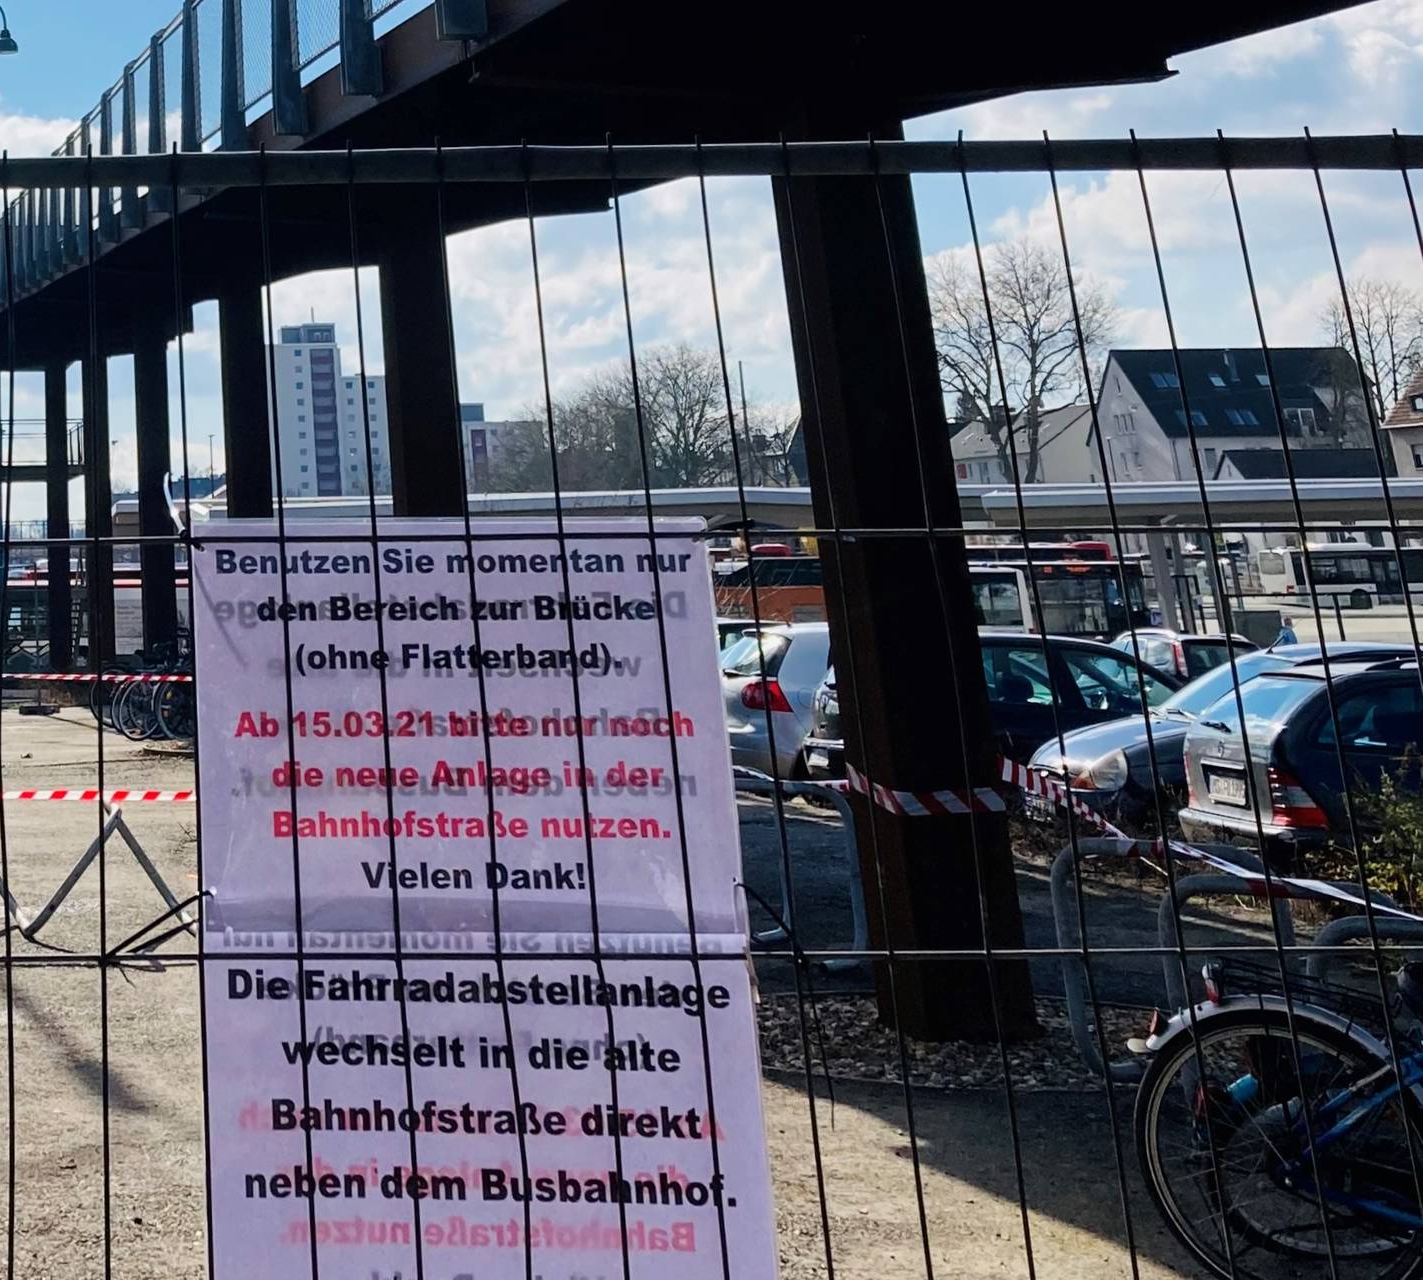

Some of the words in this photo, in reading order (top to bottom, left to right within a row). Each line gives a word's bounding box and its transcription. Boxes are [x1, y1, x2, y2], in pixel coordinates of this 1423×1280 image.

[215, 549, 371, 574] Benutzen
[382, 548, 435, 574] Sie
[446, 548, 625, 574] momentan
[636, 553, 692, 573] nur
[257, 596, 318, 621] den
[329, 595, 459, 621] Bereich
[470, 600, 523, 621] zur
[533, 594, 656, 621] Brücke
[295, 643, 389, 676] (ohne
[401, 642, 623, 676] Flatterband).
[234, 711, 280, 737] Ab
[291, 710, 434, 737] 15.03.21
[448, 710, 529, 737] bitte
[541, 717, 598, 737] nur
[609, 711, 695, 737] noch
[272, 761, 324, 787] die
[335, 766, 419, 787] neue
[431, 760, 551, 794] Anlage
[563, 761, 594, 787] in
[606, 761, 665, 787] der
[273, 810, 529, 838] Bahnhofstraße
[541, 812, 672, 838] nutzen.
[361, 862, 473, 889] Vielen
[485, 862, 586, 890] Dank!
[227, 968, 290, 1000] Die
[304, 970, 730, 1017] Fahrradabstellanlage
[281, 1034, 466, 1067] wechselt
[479, 1037, 514, 1068] in
[528, 1038, 590, 1070] die
[603, 1039, 681, 1072] alte
[272, 1098, 567, 1135] Bahnhofstraße
[580, 1104, 702, 1140] direkt
[244, 1165, 366, 1199] neben
[380, 1166, 467, 1201] dem
[480, 1167, 737, 1208] Busbahnhof.
